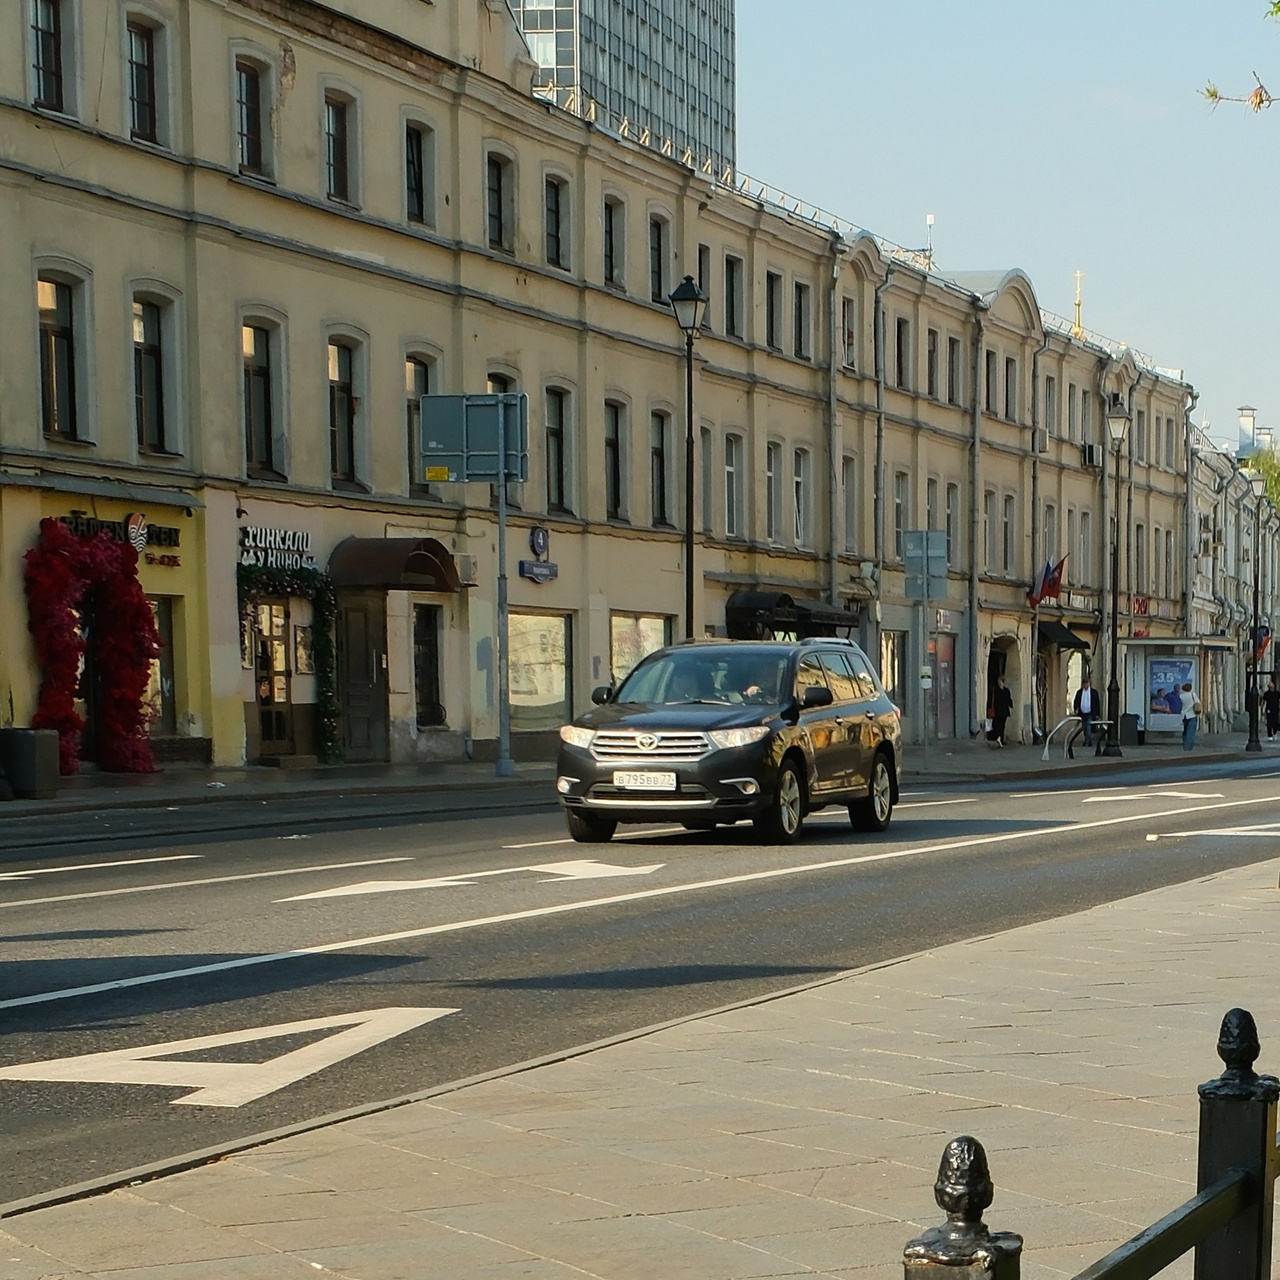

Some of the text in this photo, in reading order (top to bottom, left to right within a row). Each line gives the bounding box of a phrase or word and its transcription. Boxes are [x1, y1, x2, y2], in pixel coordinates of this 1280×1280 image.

[245, 526, 311, 551] ХИНКАЛИ
[538, 532, 543, 546] 4
[267, 548, 301, 570] НИНО
